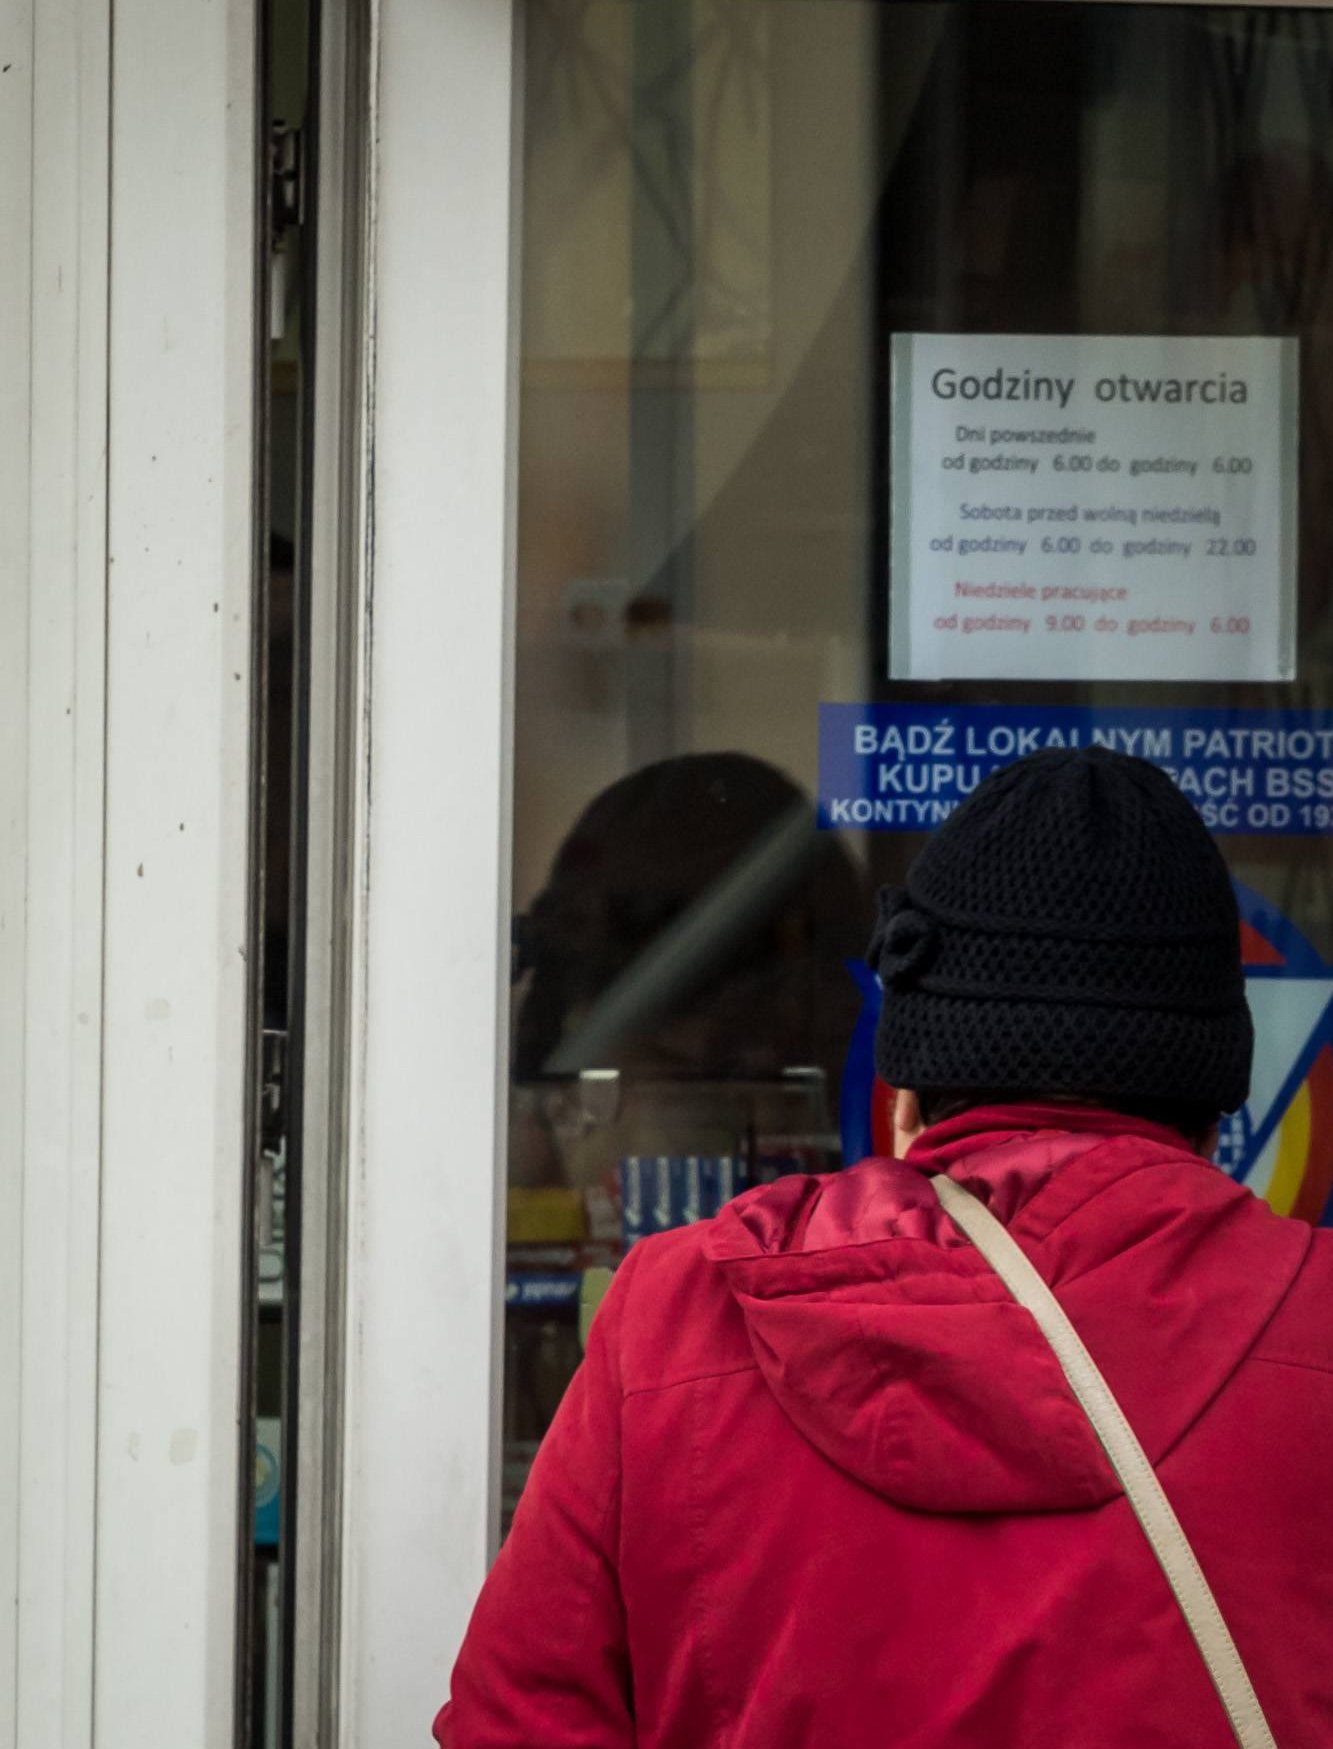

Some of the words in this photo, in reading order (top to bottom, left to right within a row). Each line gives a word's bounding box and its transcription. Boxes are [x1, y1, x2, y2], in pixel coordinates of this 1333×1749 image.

[931, 368, 1074, 408] Godziny
[1095, 372, 1247, 404] otwarcia
[956, 426, 985, 442] Dni
[990, 427, 1096, 446] powszednie
[942, 455, 964, 471] od
[969, 455, 1038, 474] godziny
[1052, 456, 1091, 472] 6.00
[1096, 457, 1119, 473] do
[1129, 458, 1198, 476] godziny
[1212, 458, 1252, 474] 6.00
[959, 504, 1022, 521] Sobota
[1027, 505, 1077, 524] przed
[1083, 506, 1136, 526] wolną
[1141, 508, 1221, 527] niedzielą
[930, 537, 952, 552] od
[958, 538, 1026, 556] godziny
[1041, 538, 1080, 554] 6.00
[1089, 539, 1112, 554] do
[1122, 539, 1191, 558] godziny
[1206, 540, 1256, 556] 22.00
[955, 583, 1035, 599] Niedziele
[1041, 584, 1128, 603] pracujące
[934, 615, 957, 631] od
[962, 616, 1031, 634] godziny
[1046, 616, 1085, 632] 9.00
[1094, 617, 1118, 633] do
[1127, 618, 1195, 636] godziny
[1210, 618, 1250, 634] 6.00
[854, 718, 955, 760] BĄDŹ
[1247, 803, 1290, 828] OD
